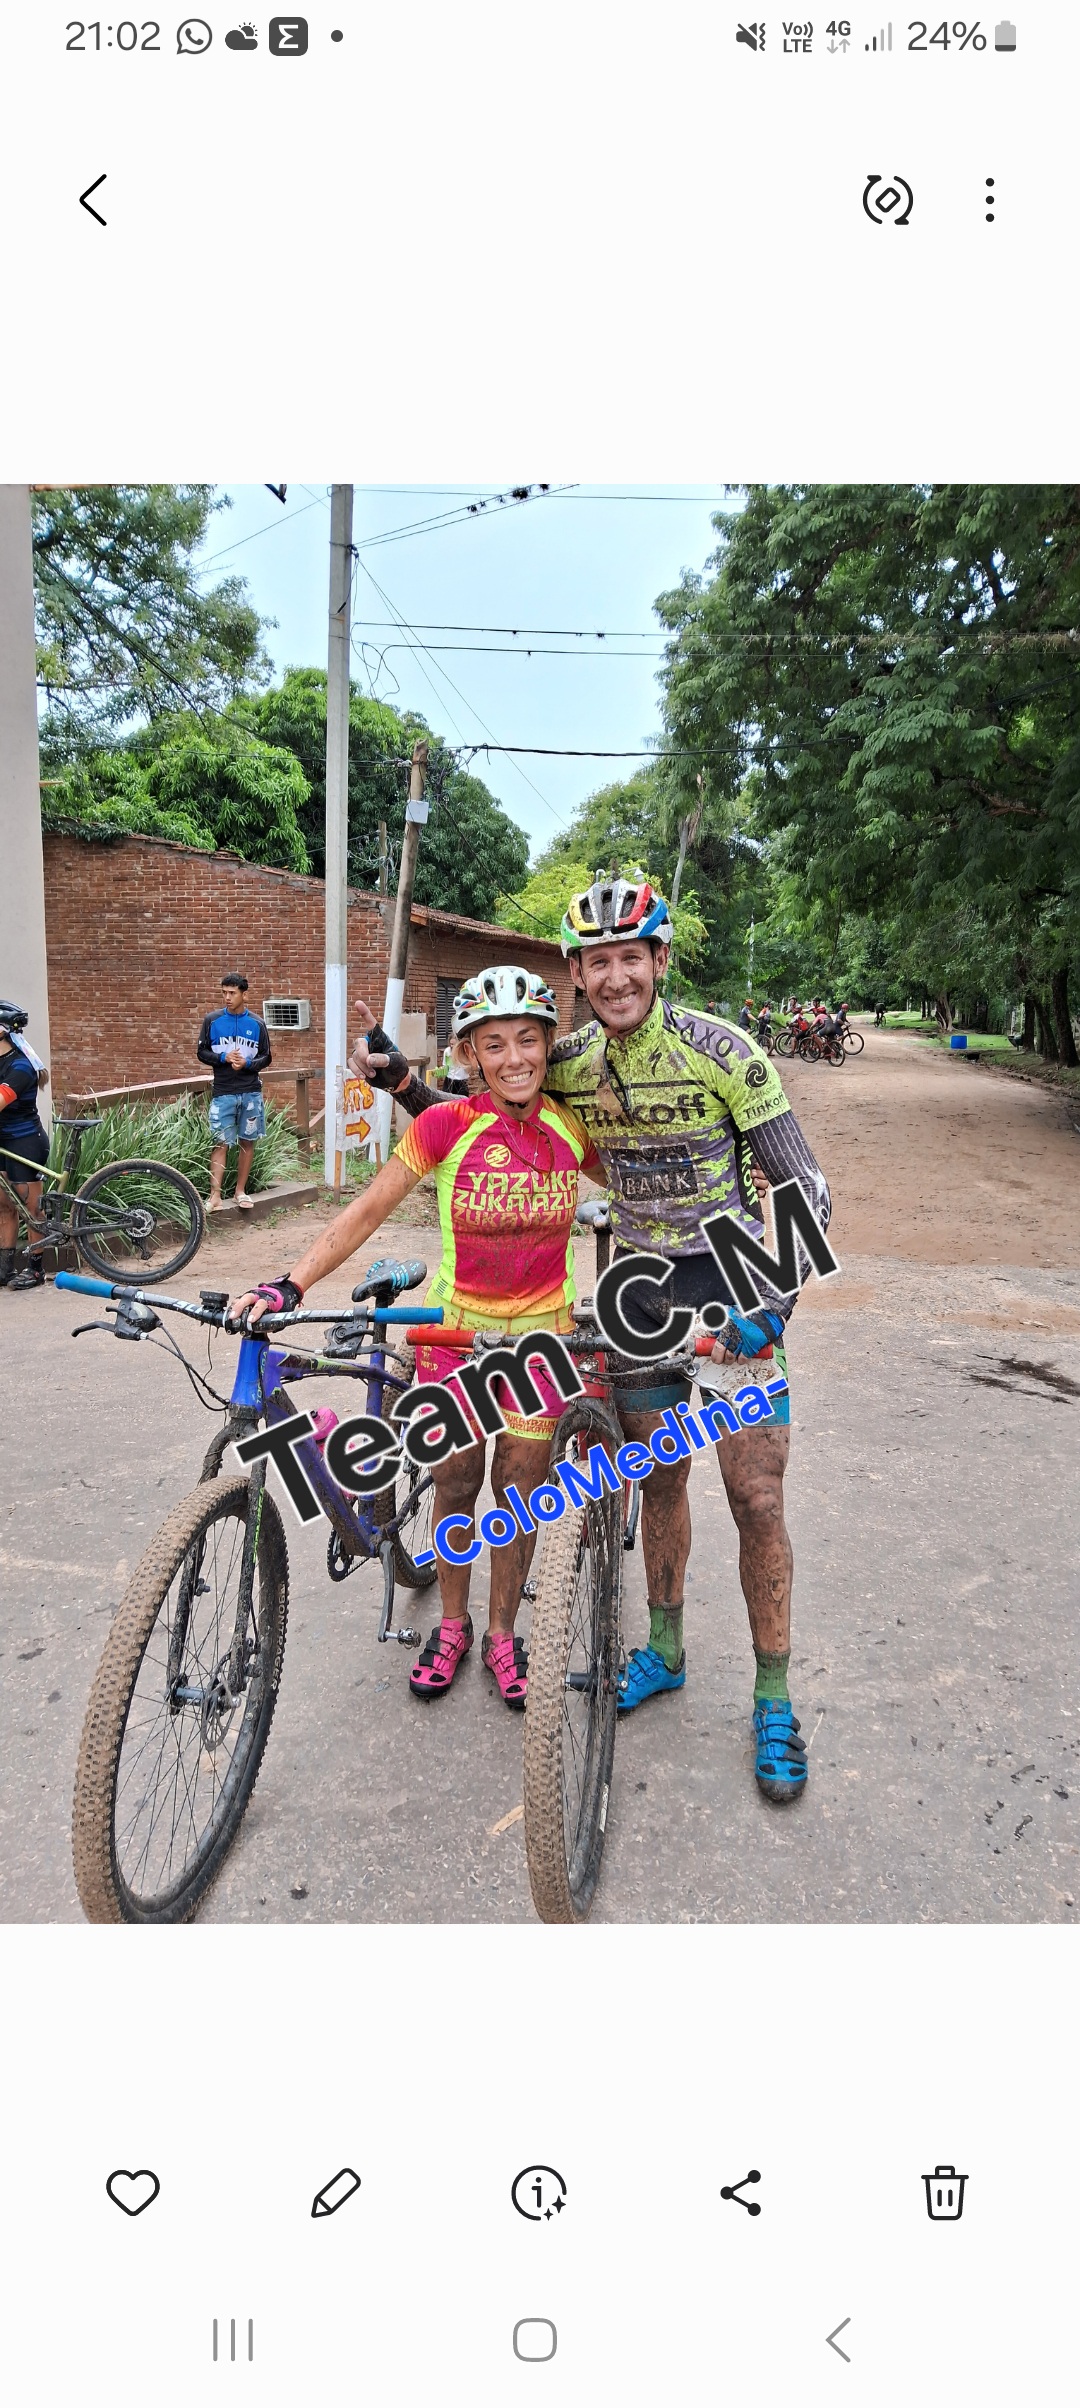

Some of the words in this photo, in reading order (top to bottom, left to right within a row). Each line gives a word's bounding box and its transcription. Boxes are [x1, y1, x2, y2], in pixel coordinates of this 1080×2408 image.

[66, 21, 161, 51] 21:02
[825, 20, 852, 37] 4G
[908, 20, 988, 52] 24%
[782, 38, 813, 54] LTE
[467, 1169, 578, 1194] YAZUKA
[625, 1171, 692, 1195] BANK
